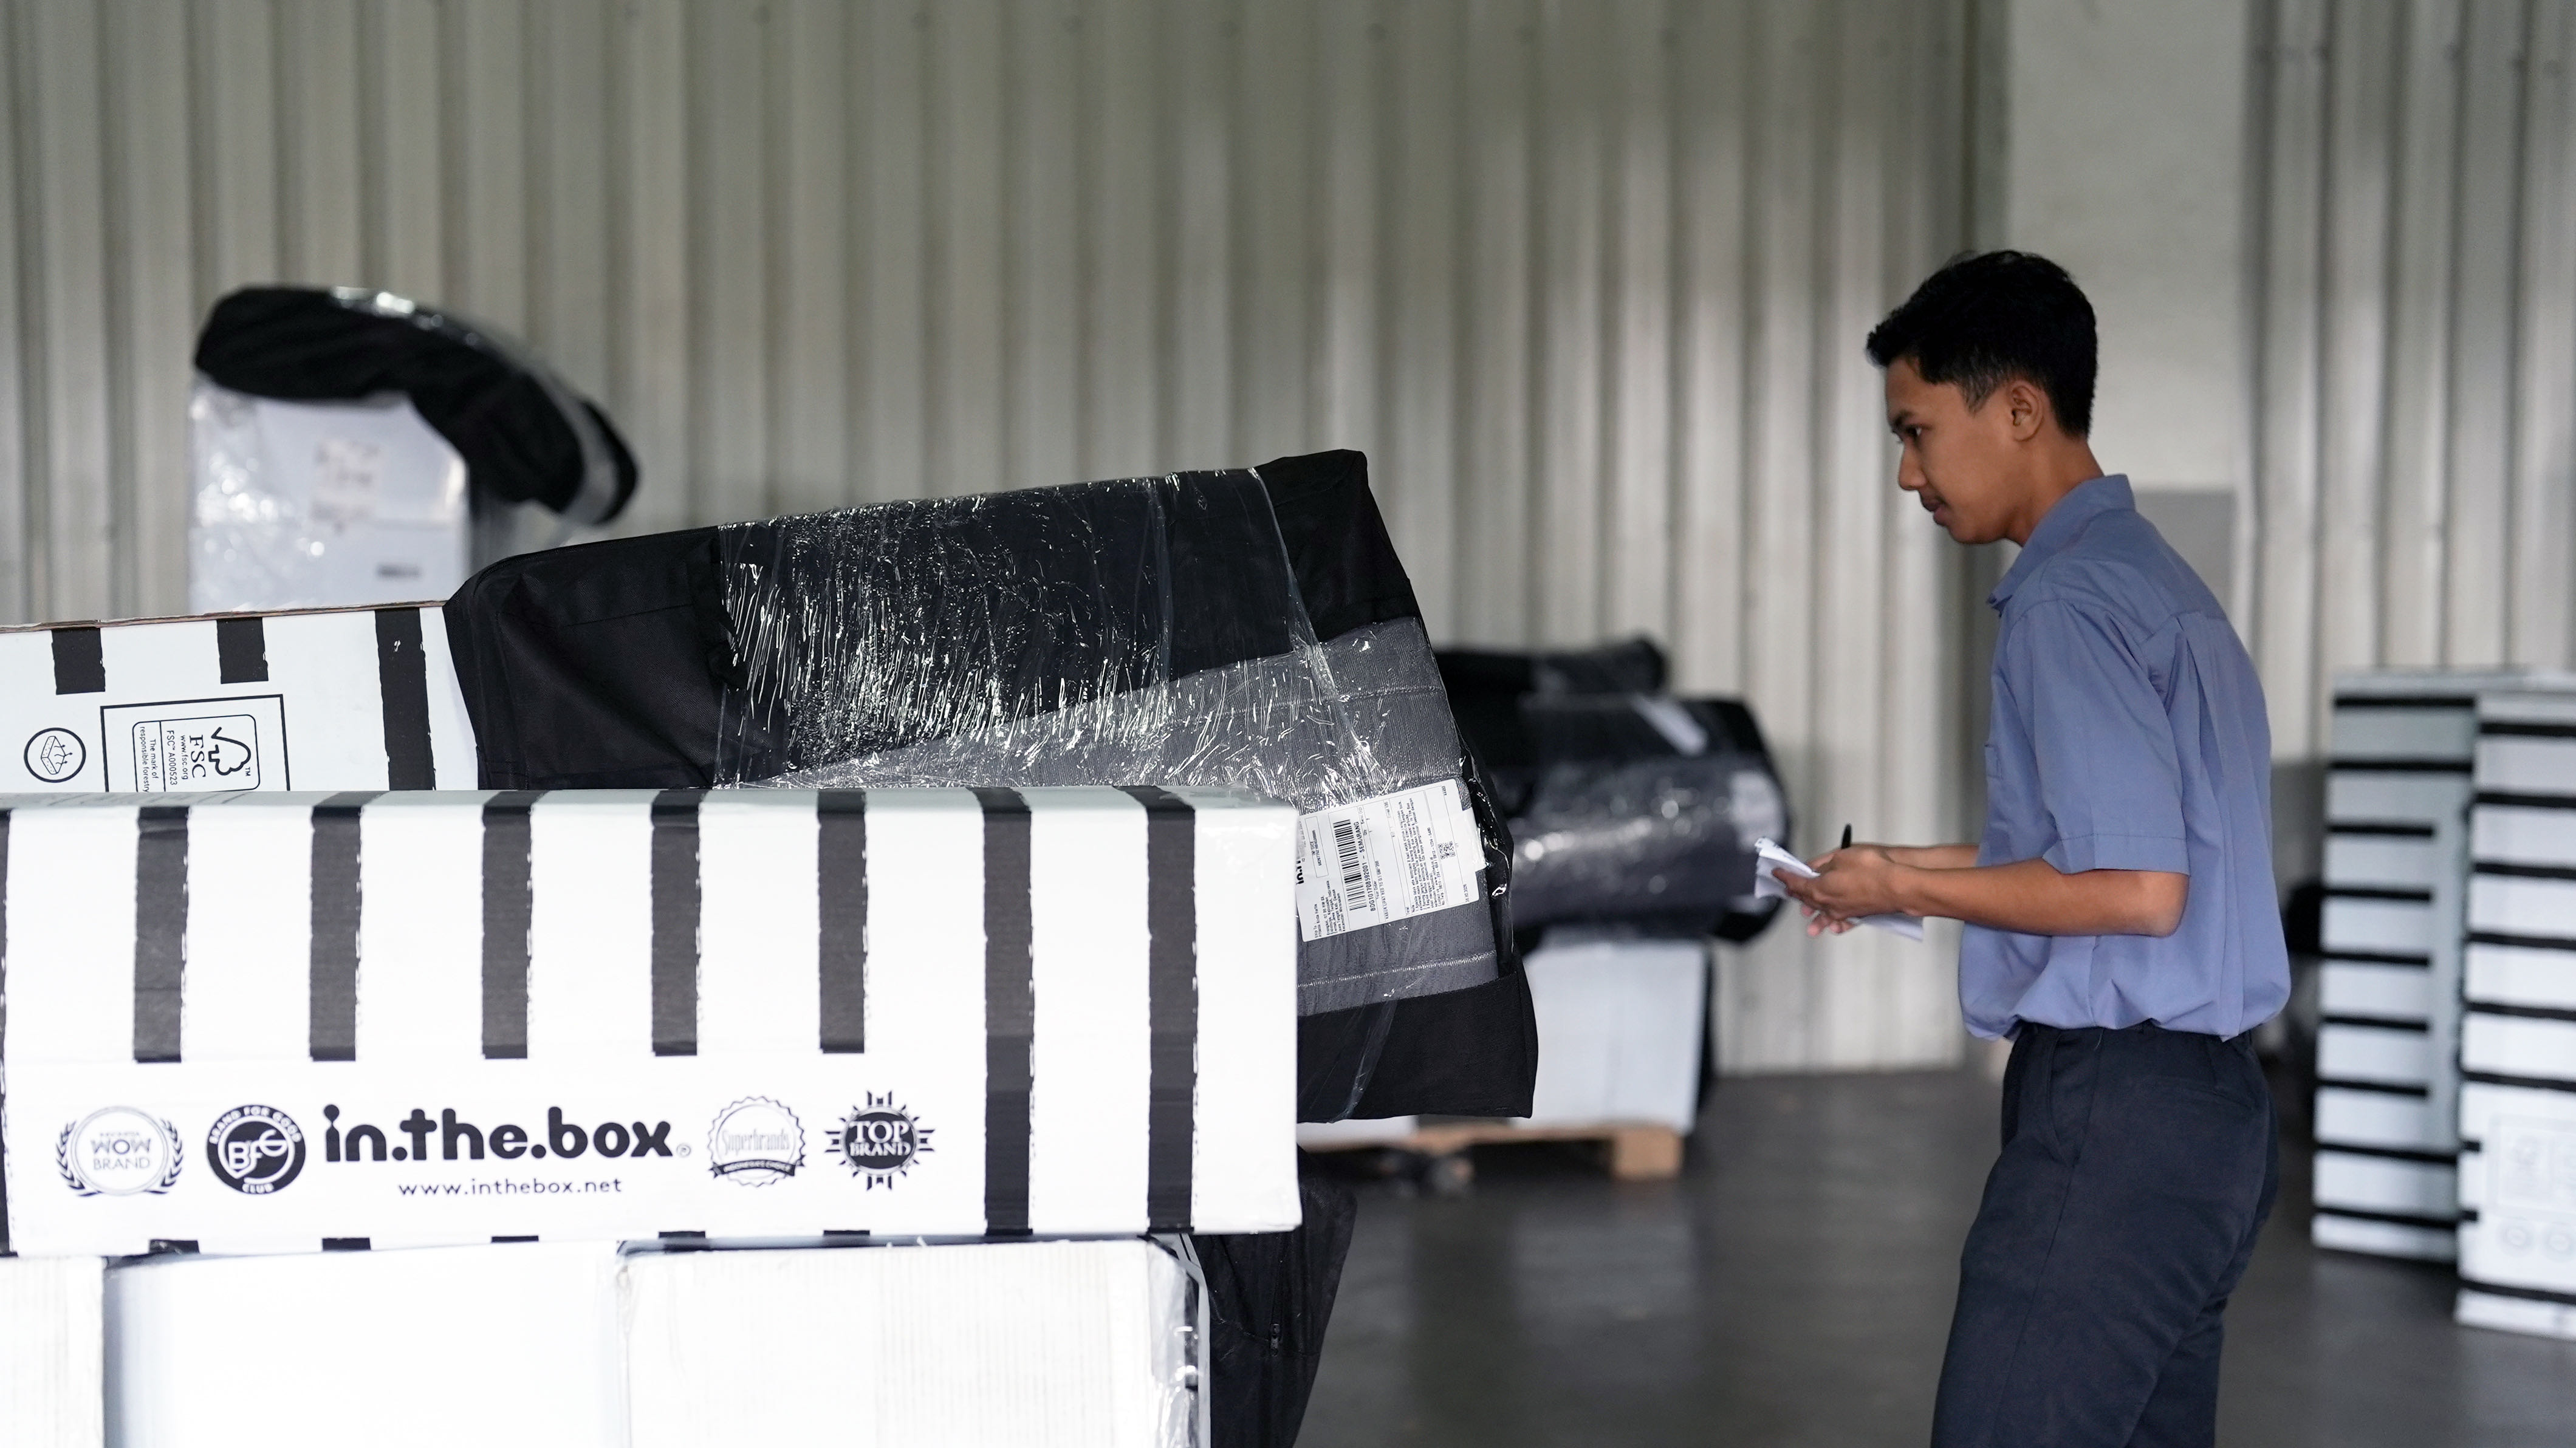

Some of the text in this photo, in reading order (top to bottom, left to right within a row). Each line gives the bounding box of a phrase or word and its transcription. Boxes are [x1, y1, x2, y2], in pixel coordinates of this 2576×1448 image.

[140, 726, 148, 765] responsible
[190, 735, 206, 778] FSC
[1355, 821, 1365, 853] SEMARANG
[209, 1105, 303, 1144] BRAND FOR GOOD
[323, 1104, 673, 1162] in.the.box
[849, 1121, 909, 1143] TOP
[91, 1138, 151, 1155] WOW
[721, 1128, 790, 1156] Superbrands
[849, 1142, 912, 1157] BRAND
[93, 1157, 151, 1170] BRAND
[241, 1183, 275, 1194] CLUB
[398, 1178, 622, 1197] www.inthebox.net
